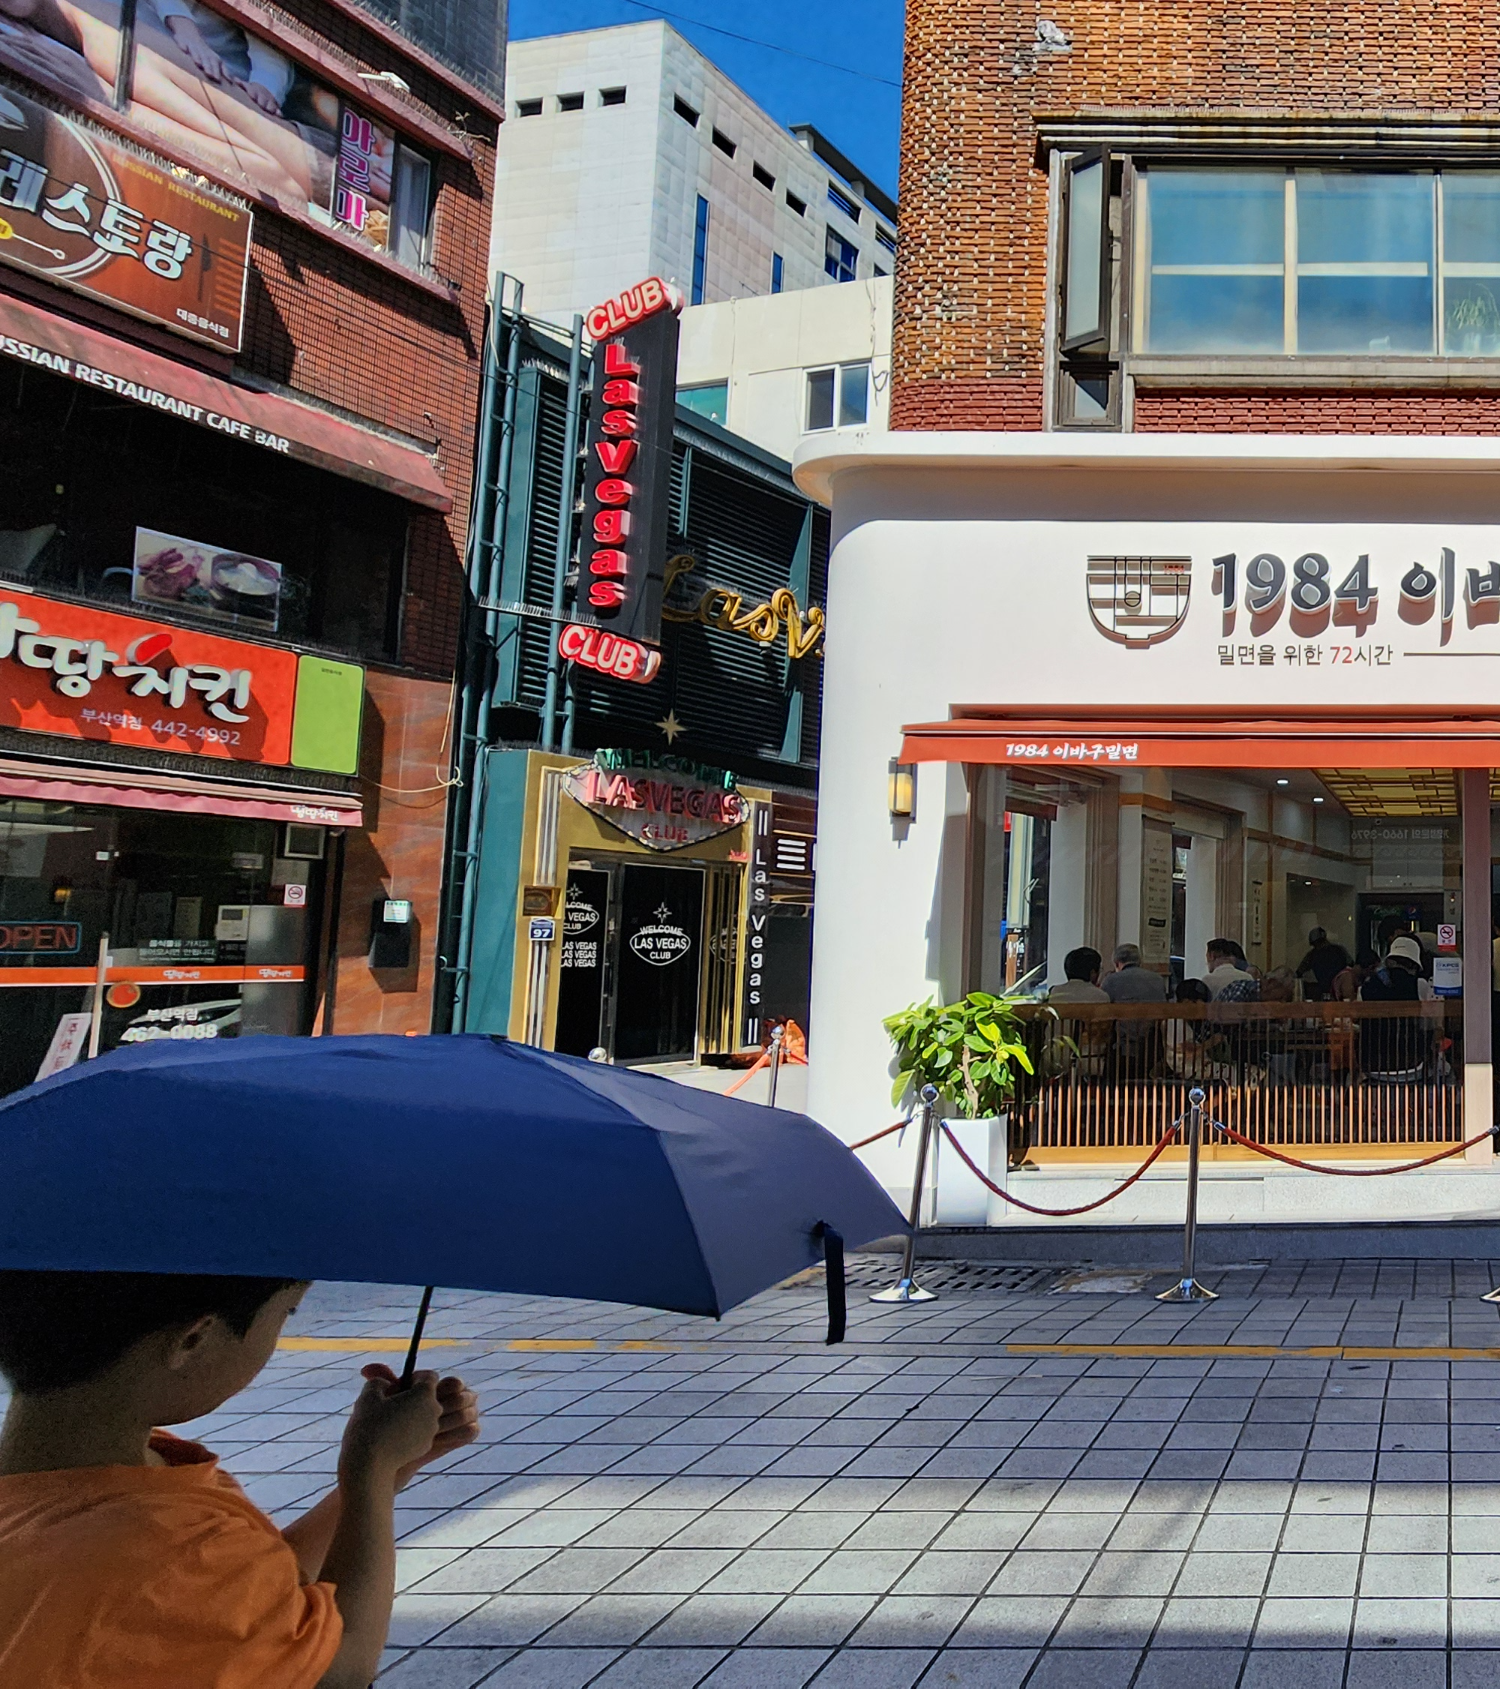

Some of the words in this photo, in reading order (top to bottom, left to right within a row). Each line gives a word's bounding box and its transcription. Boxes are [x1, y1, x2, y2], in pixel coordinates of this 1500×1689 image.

[339, 106, 376, 232] 아로마
[167, 182, 241, 222] RESTAURANT
[587, 278, 665, 341] CLUB
[74, 361, 204, 422] RESTAURANT
[206, 411, 252, 440] CAFE
[254, 429, 291, 454] BAR
[1211, 552, 1379, 614] 1984
[561, 624, 639, 680] CLUB
[1217, 644, 1276, 667] 밀면을
[1283, 644, 1323, 667] 위한
[1329, 644, 1394, 667] 72시간
[81, 707, 143, 731] 부산역점
[151, 719, 242, 746] 442-4992
[1006, 743, 1049, 758] 1984
[1052, 742, 1139, 761] 이바구밀면
[642, 823, 689, 843] CLUB
[565, 901, 593, 911] LCOME
[567, 911, 597, 922] VEGAS
[533, 928, 551, 938] 97
[640, 924, 684, 936] WELCOME
[575, 941, 597, 950] VEGAS
[634, 937, 654, 949] LAS
[655, 937, 687, 949] VEGAS
[574, 950, 597, 959] VEGAS
[574, 959, 596, 968] VEGAS
[650, 951, 671, 960] CLUB
